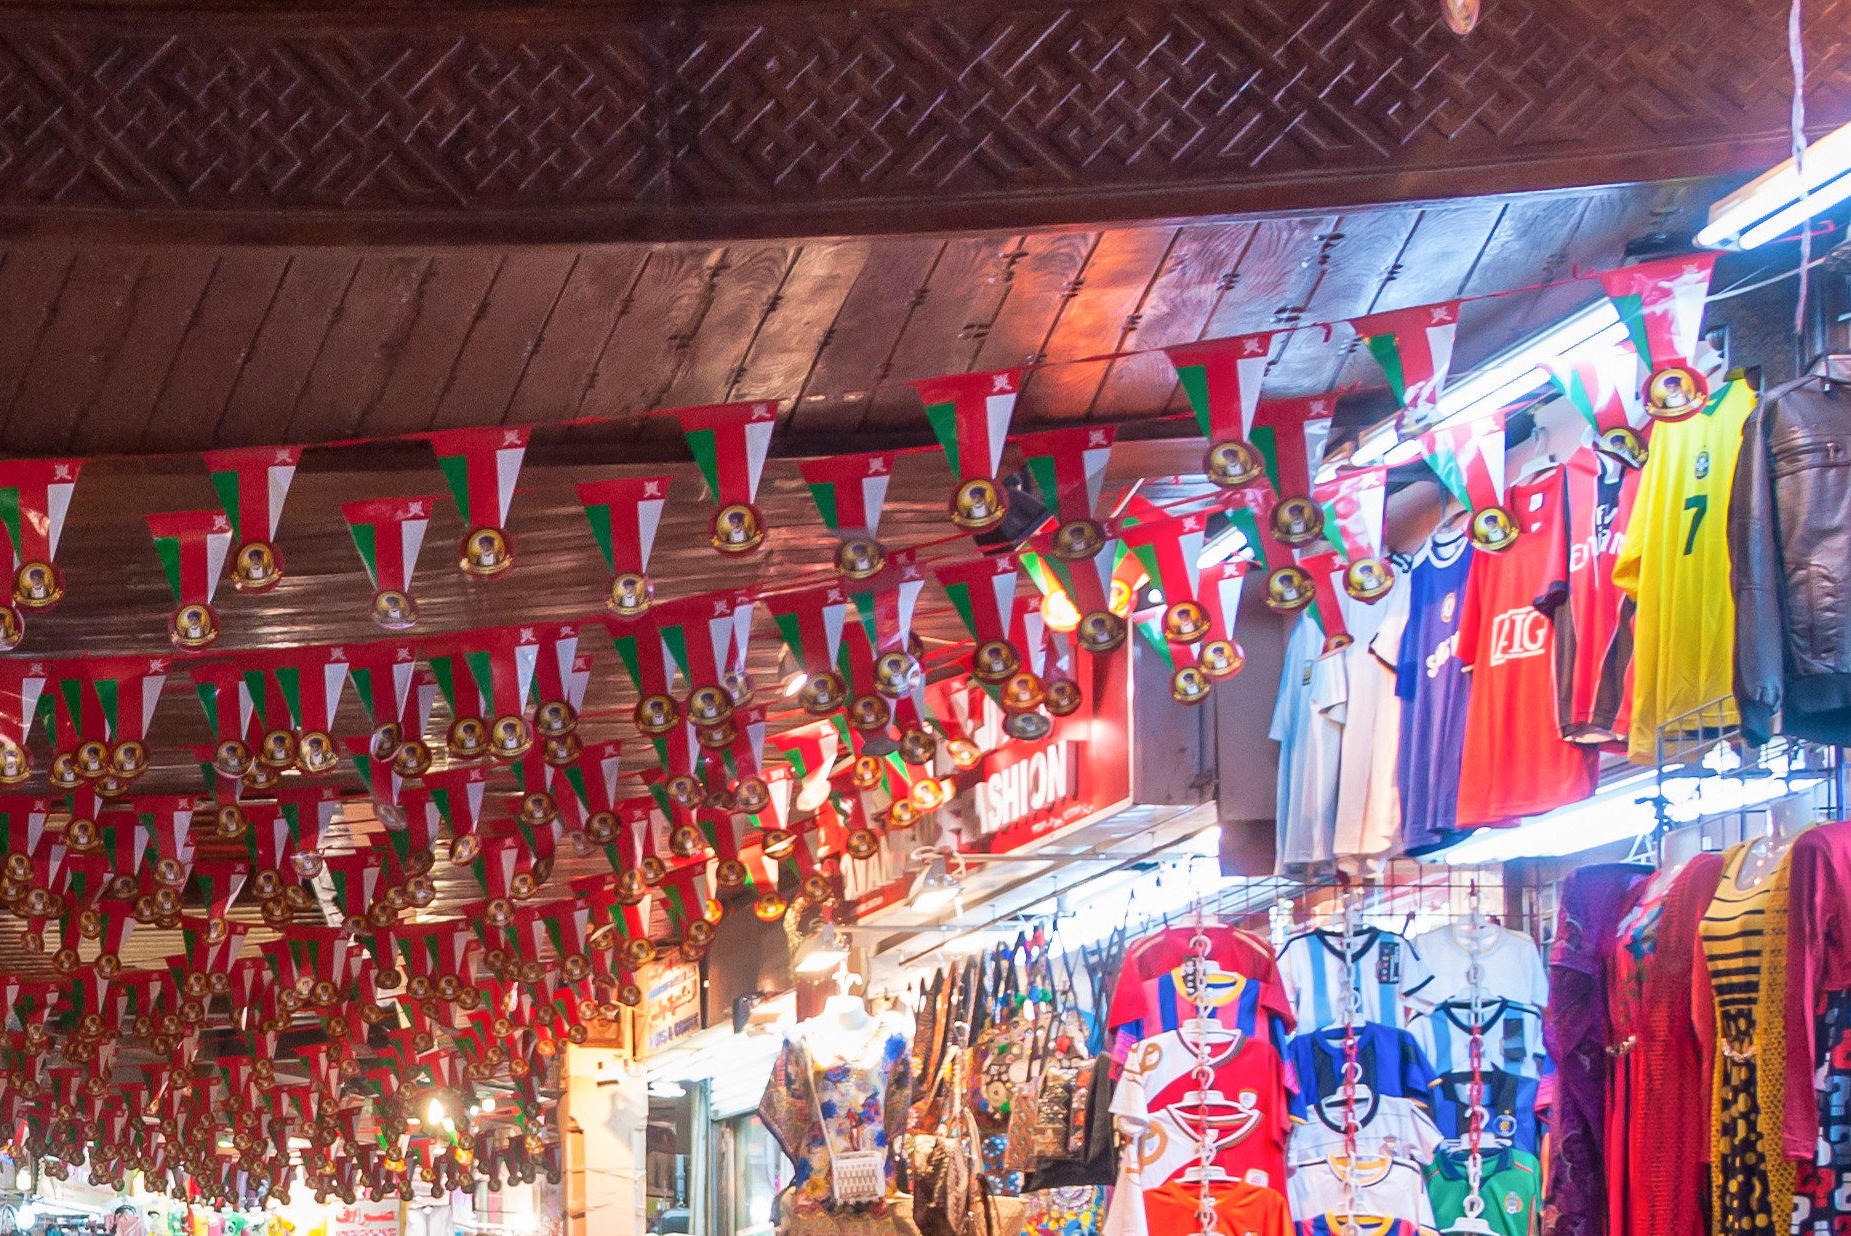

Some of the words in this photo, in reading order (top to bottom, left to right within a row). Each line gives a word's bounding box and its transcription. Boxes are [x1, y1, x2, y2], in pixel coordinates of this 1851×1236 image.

[1684, 494, 1709, 556] 7
[1494, 609, 1547, 659] AIG
[975, 739, 1067, 835] SHION
